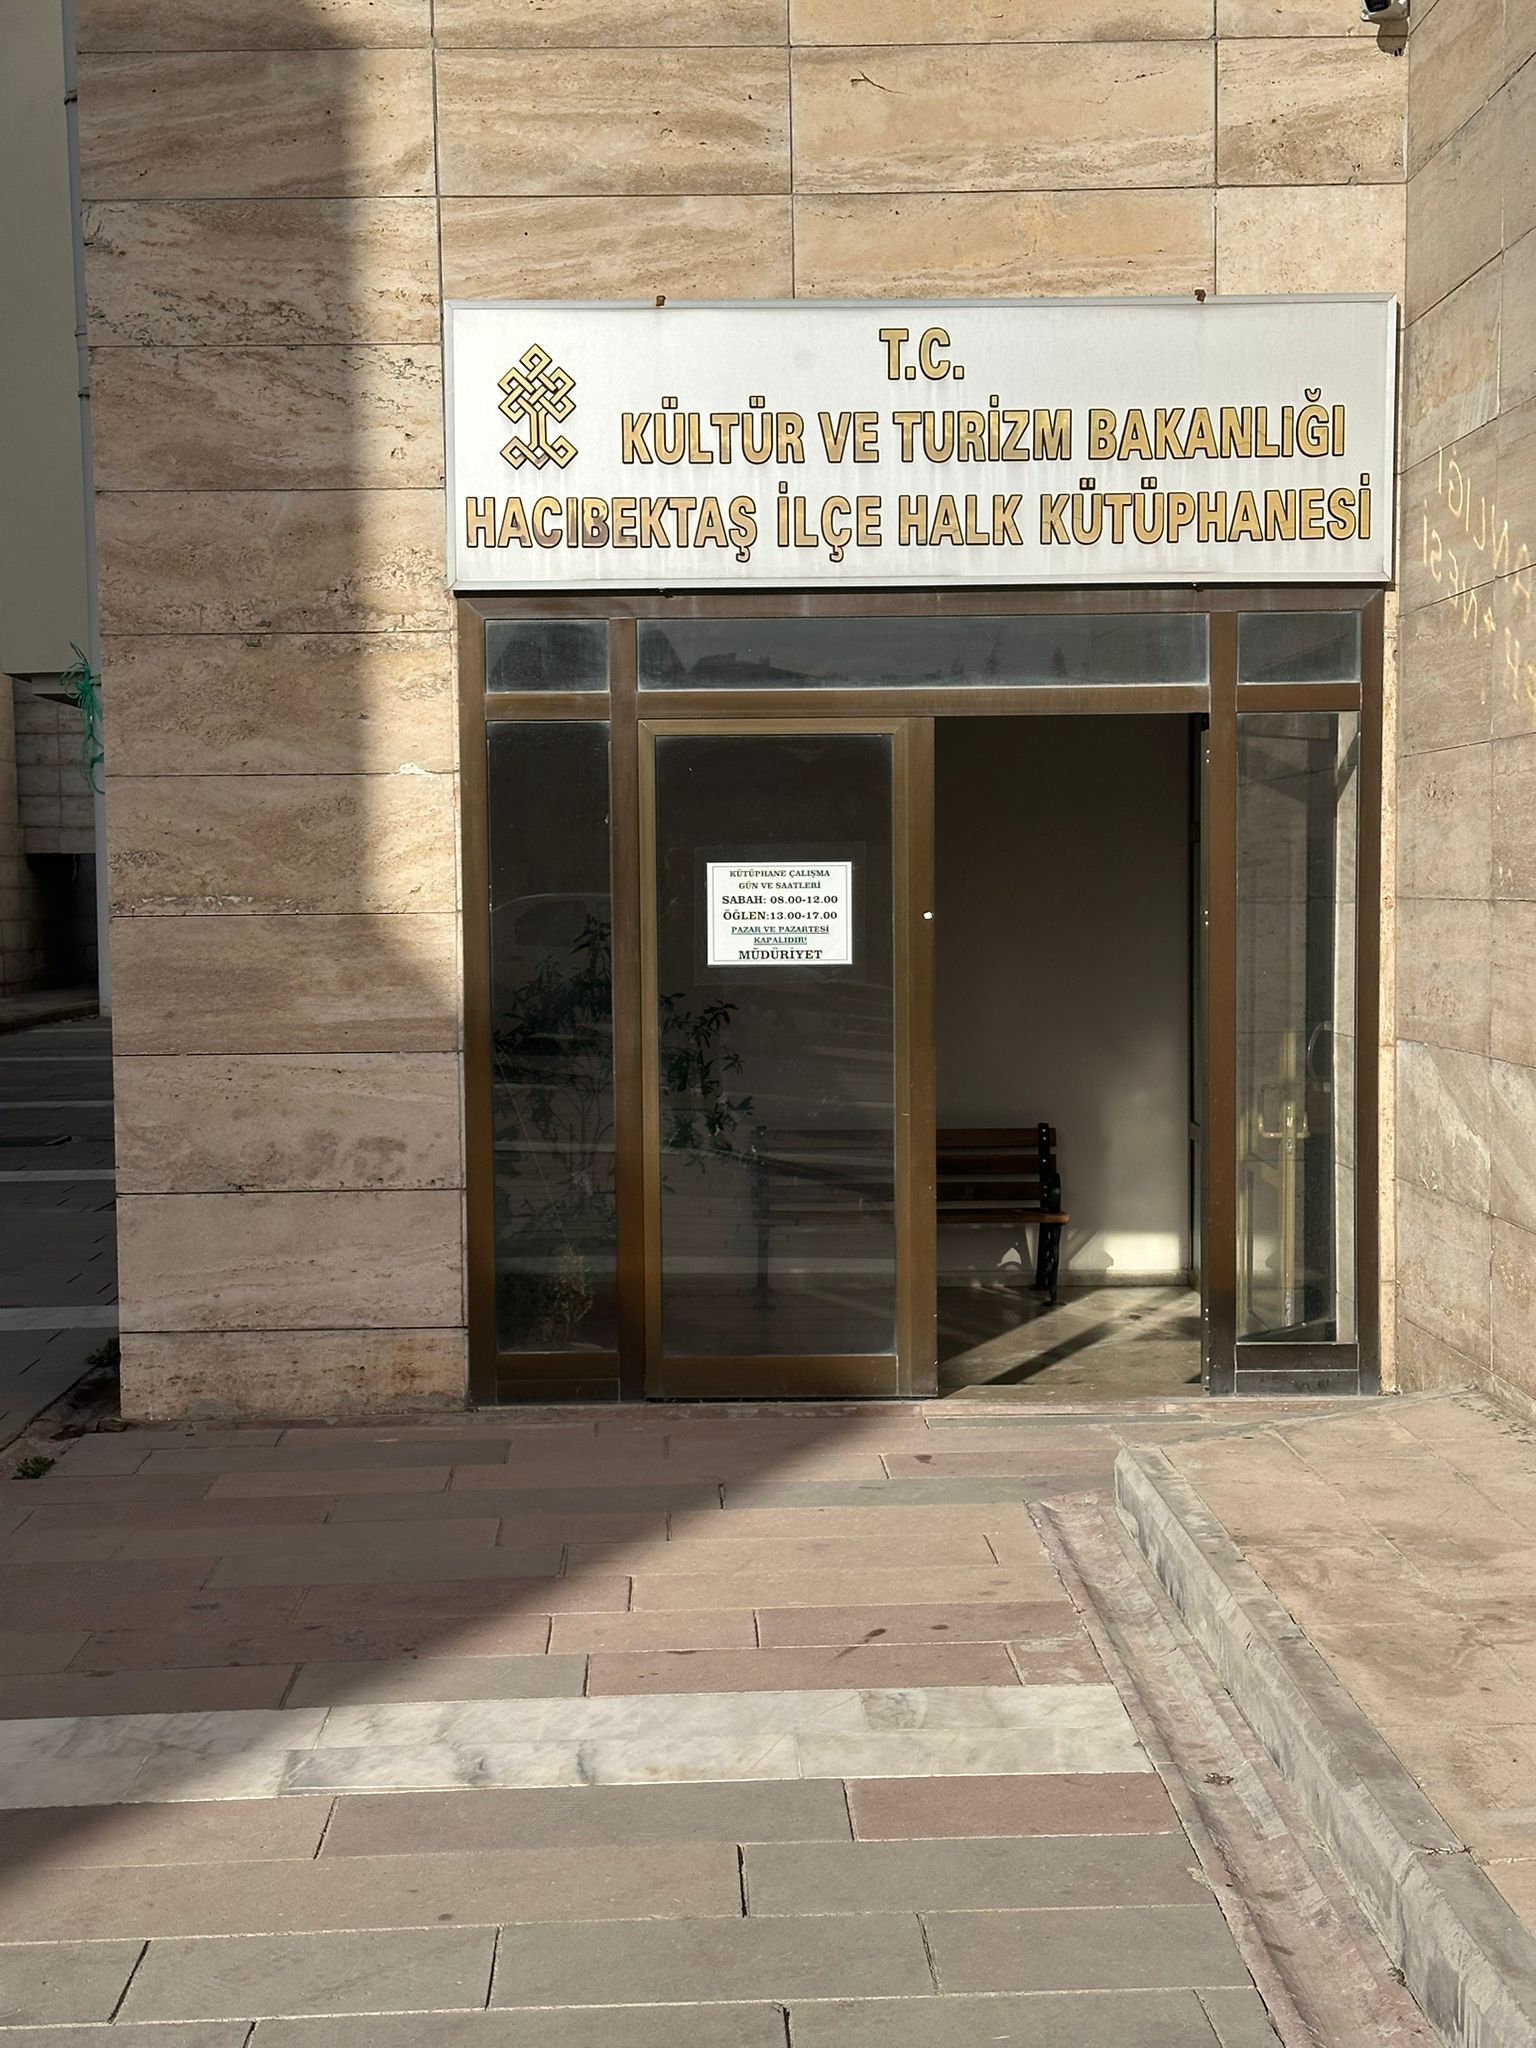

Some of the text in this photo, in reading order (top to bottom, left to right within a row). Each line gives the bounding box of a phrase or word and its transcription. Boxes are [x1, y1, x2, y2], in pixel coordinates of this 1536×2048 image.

[879, 327, 965, 381] T.C.
[621, 388, 1345, 464] KÜLTÜR VE TURİZM BAKANLIĞI
[465, 473, 1372, 563] HACIBEKTAŞ İLÇE HALK KÜTÜPHANESİ
[729, 869, 831, 879] KÜTÜPHANE ÇALIŞMA
[738, 881, 759, 890] GÜN
[775, 881, 821, 889] SAATLERİ
[721, 895, 838, 905] SABAH: 08.00-12.00
[731, 926, 761, 934] PAZAR
[778, 924, 829, 933] PAZARTESİ
[753, 936, 807, 945] KAPALIDIR!
[738, 947, 823, 960] MÜDÜRİYET
